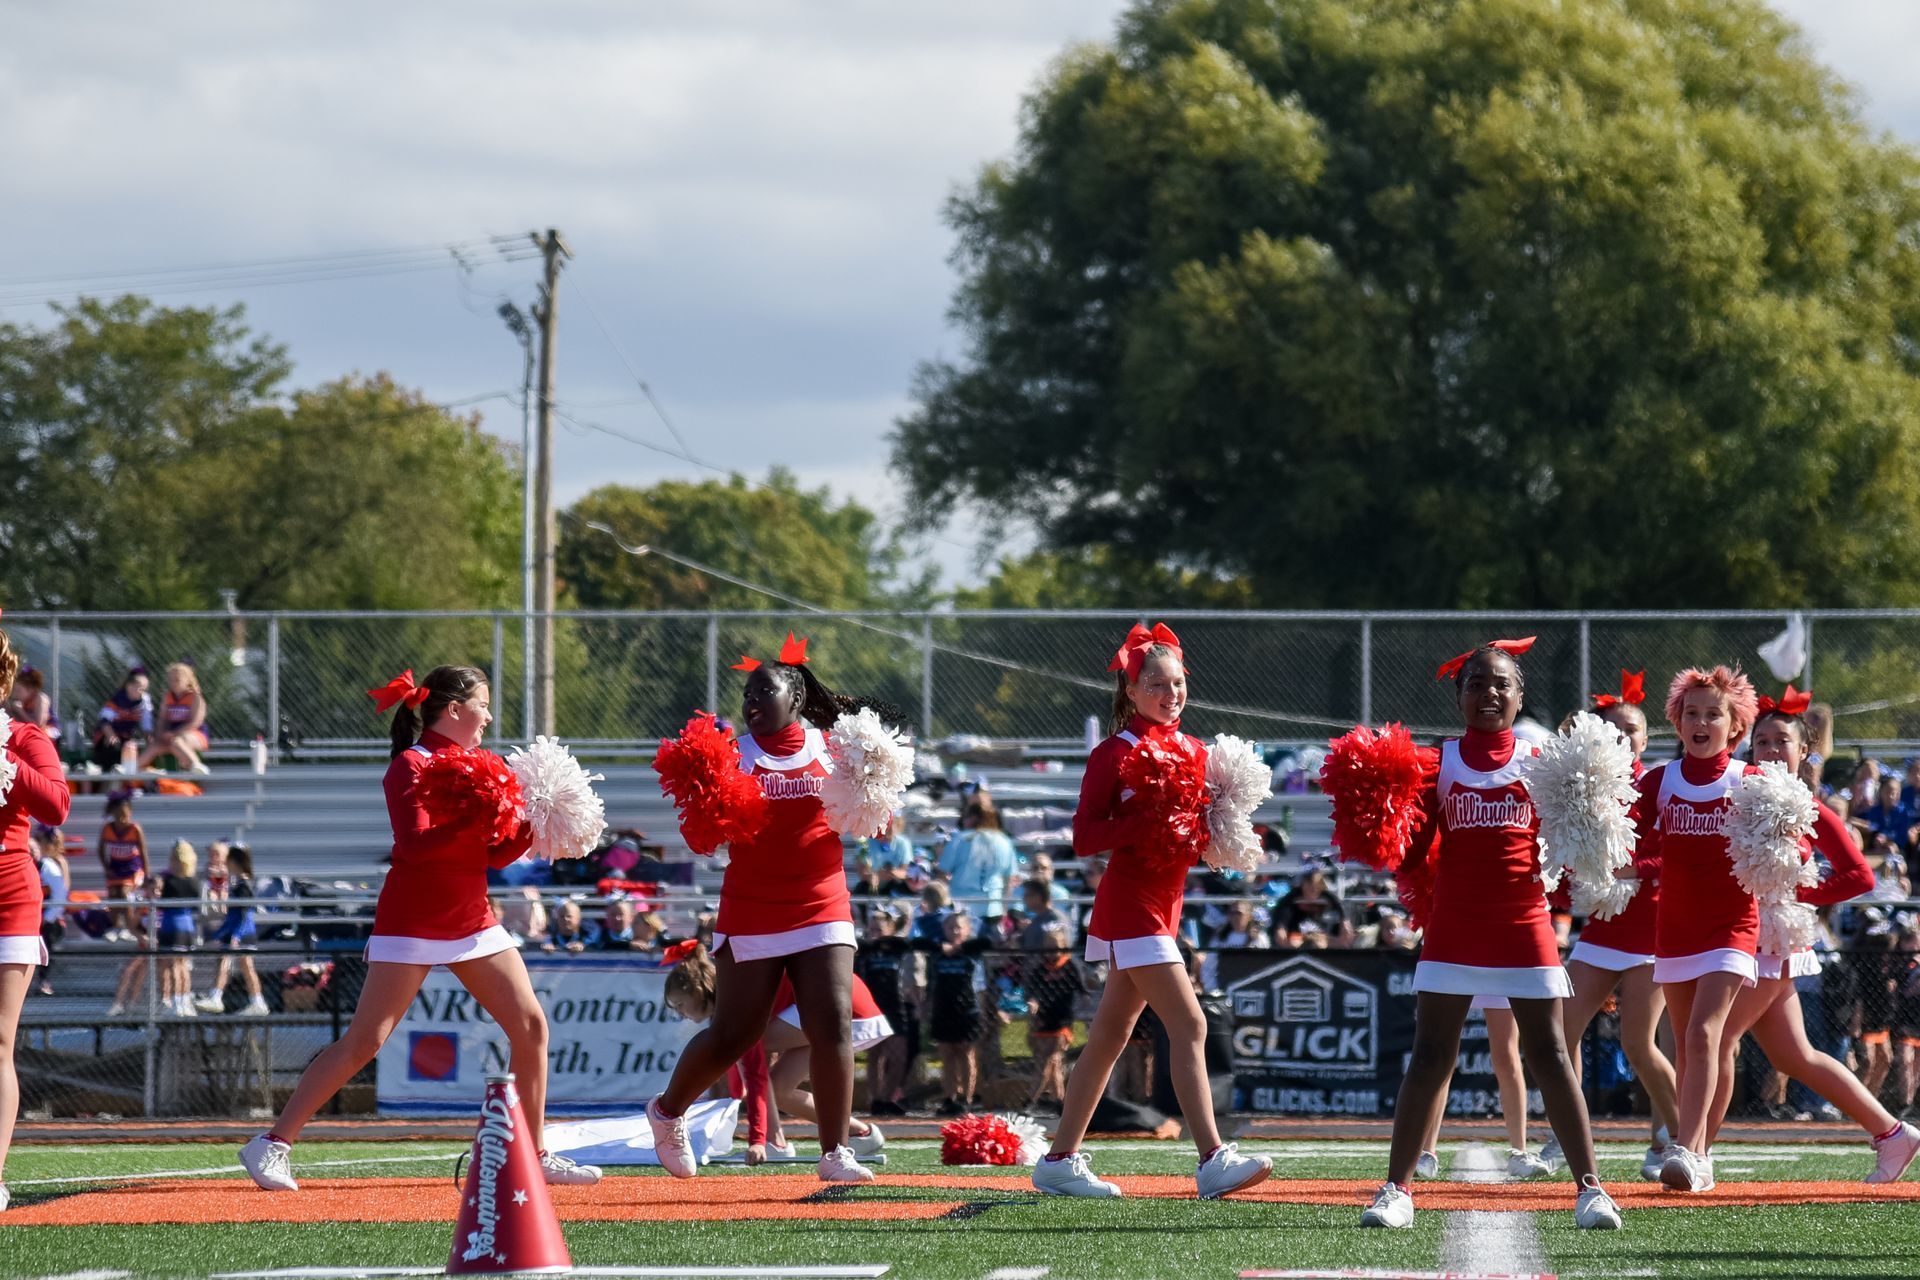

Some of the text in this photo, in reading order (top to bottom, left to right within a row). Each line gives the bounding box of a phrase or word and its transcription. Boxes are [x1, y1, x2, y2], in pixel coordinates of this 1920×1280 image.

[759, 772, 825, 799] illionaire
[1443, 792, 1532, 831] Millionaires
[479, 1040, 604, 1076] Nrth,
[1233, 1025, 1370, 1060] GLICK
[1252, 1086, 1379, 1114] GLICKS.COM
[477, 1098, 516, 1258] Millionaires
